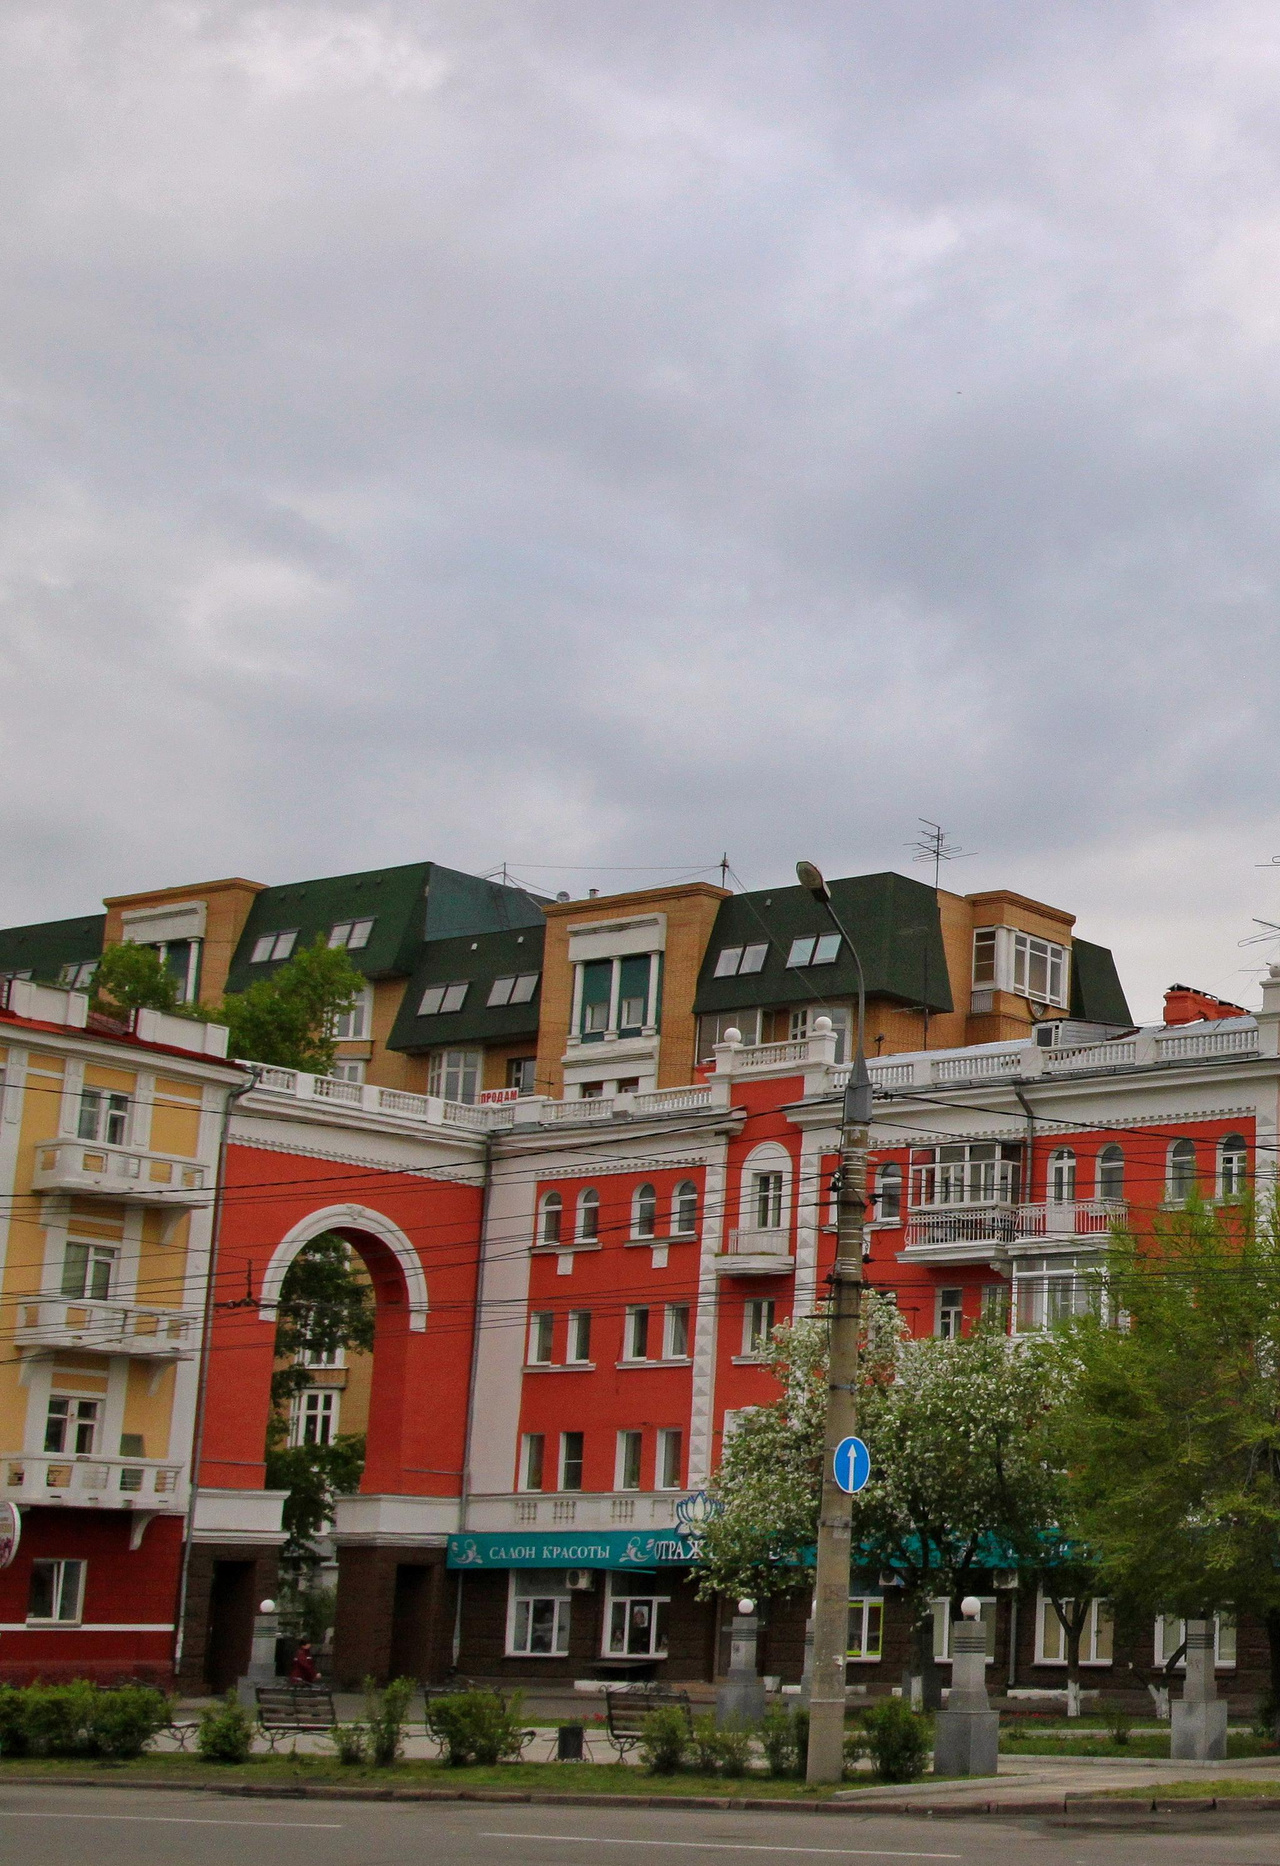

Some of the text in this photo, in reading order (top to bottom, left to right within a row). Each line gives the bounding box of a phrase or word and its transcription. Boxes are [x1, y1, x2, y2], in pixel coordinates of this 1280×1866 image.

[480, 1090, 518, 1104] ПРОДАМ
[489, 1545, 610, 1560] САЛОН КРАСОТЫ
